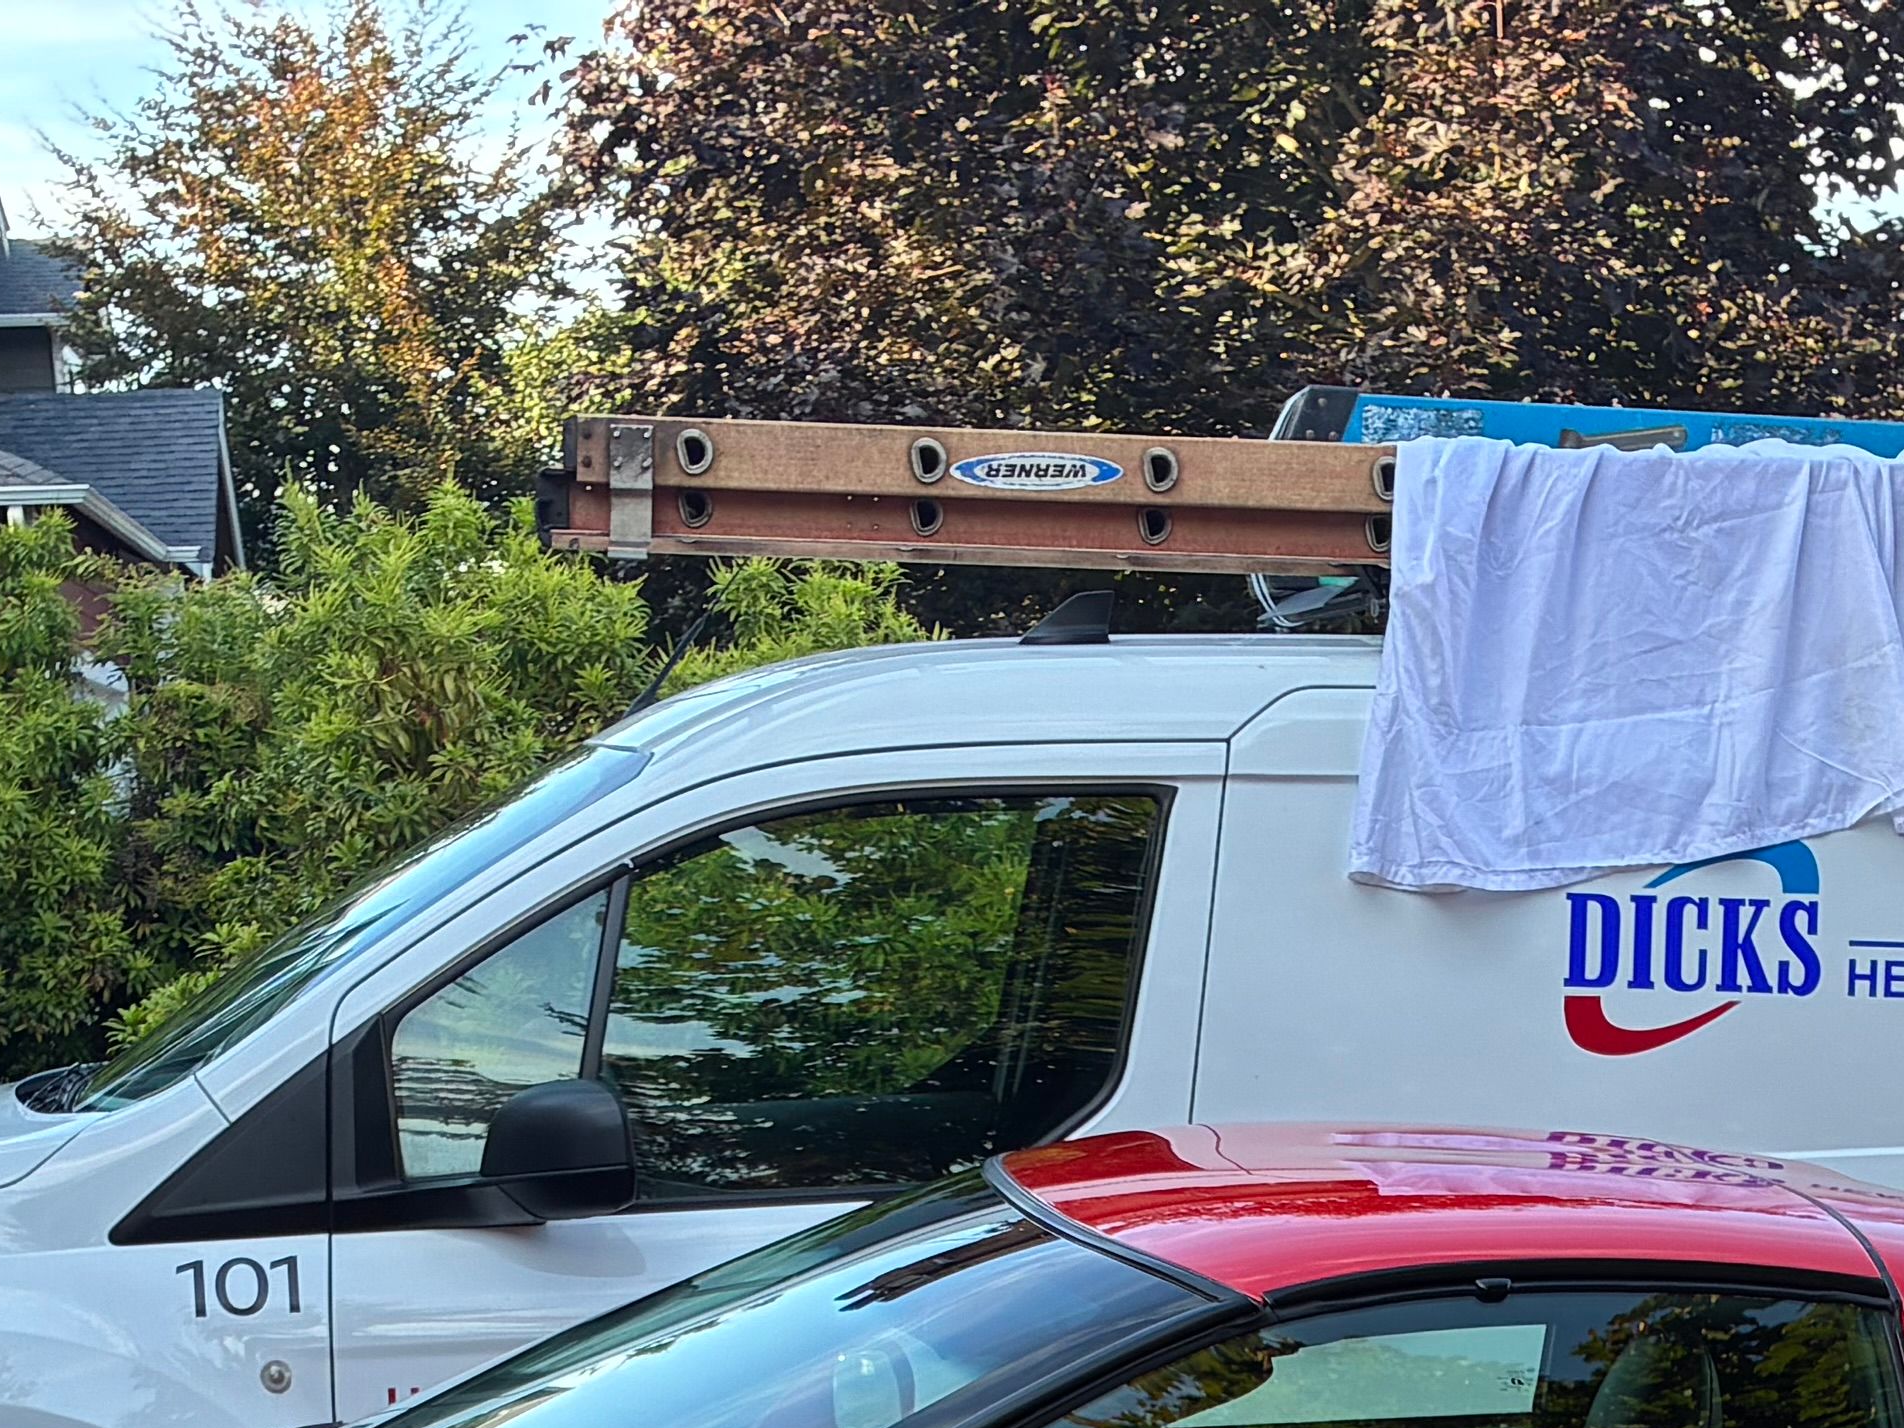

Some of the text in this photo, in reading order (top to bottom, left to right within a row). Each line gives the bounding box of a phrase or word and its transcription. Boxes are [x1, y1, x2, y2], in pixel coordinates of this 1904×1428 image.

[985, 462, 1087, 479] WERNER
[1563, 892, 1821, 997] DICKS
[175, 1255, 301, 1318] 101
